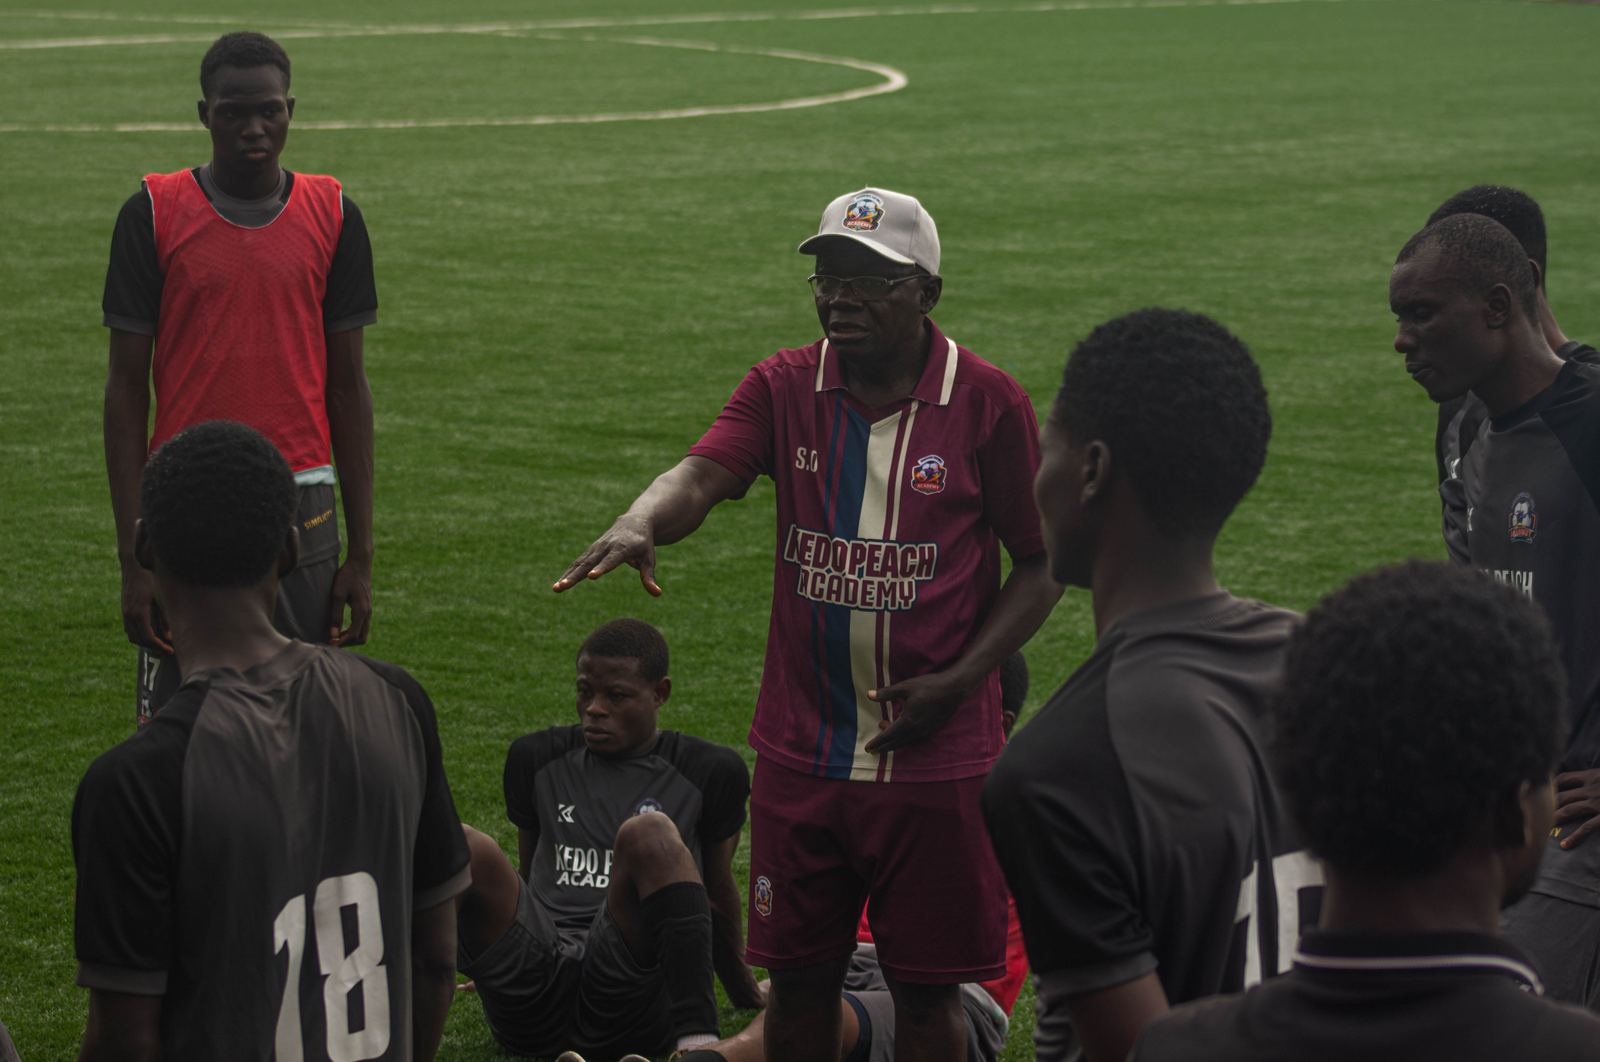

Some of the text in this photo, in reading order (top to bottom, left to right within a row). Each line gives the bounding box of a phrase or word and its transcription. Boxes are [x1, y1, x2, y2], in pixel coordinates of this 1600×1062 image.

[798, 568, 916, 610] ACADEMY
[143, 651, 161, 692] 17
[554, 843, 599, 875] KEDO
[556, 871, 610, 889] ACAD
[273, 871, 391, 1062] 18
